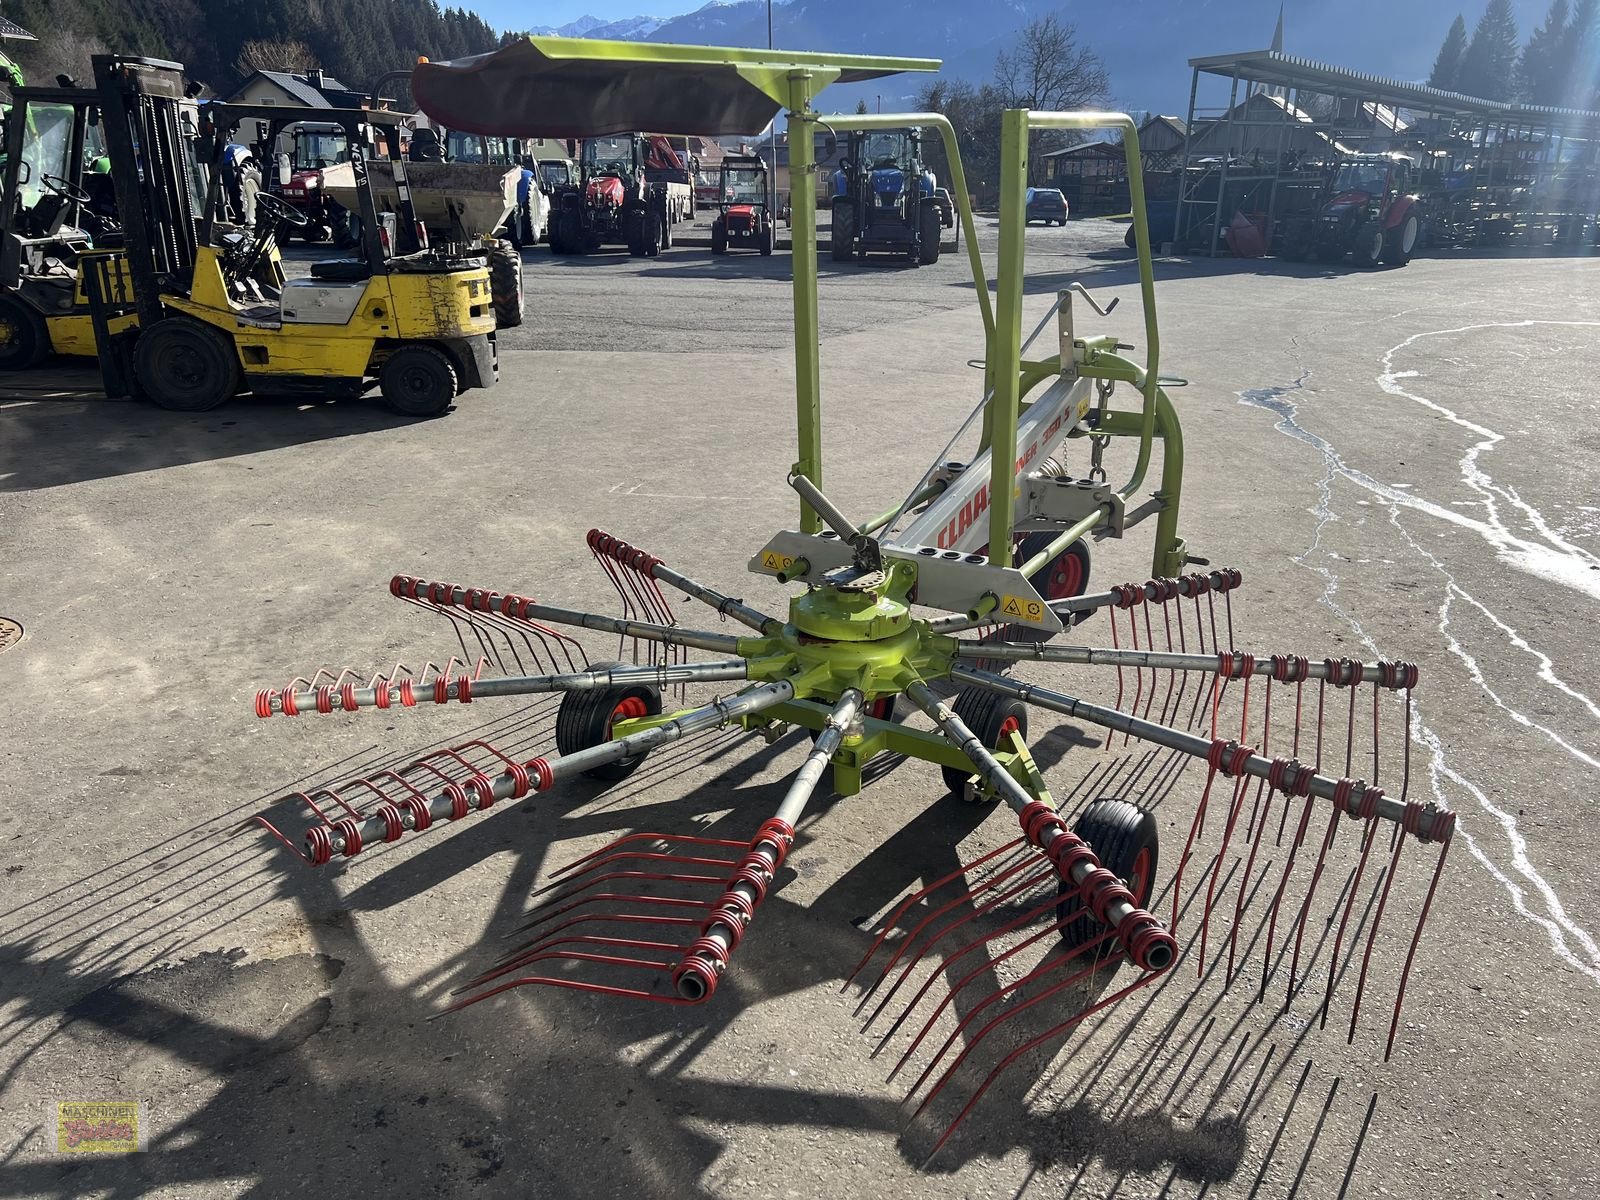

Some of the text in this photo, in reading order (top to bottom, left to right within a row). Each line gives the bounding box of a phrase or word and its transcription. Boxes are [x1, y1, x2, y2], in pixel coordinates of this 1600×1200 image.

[351, 143, 364, 174] NEW
[937, 480, 992, 549] CLAA
[1015, 441, 1037, 475] INER
